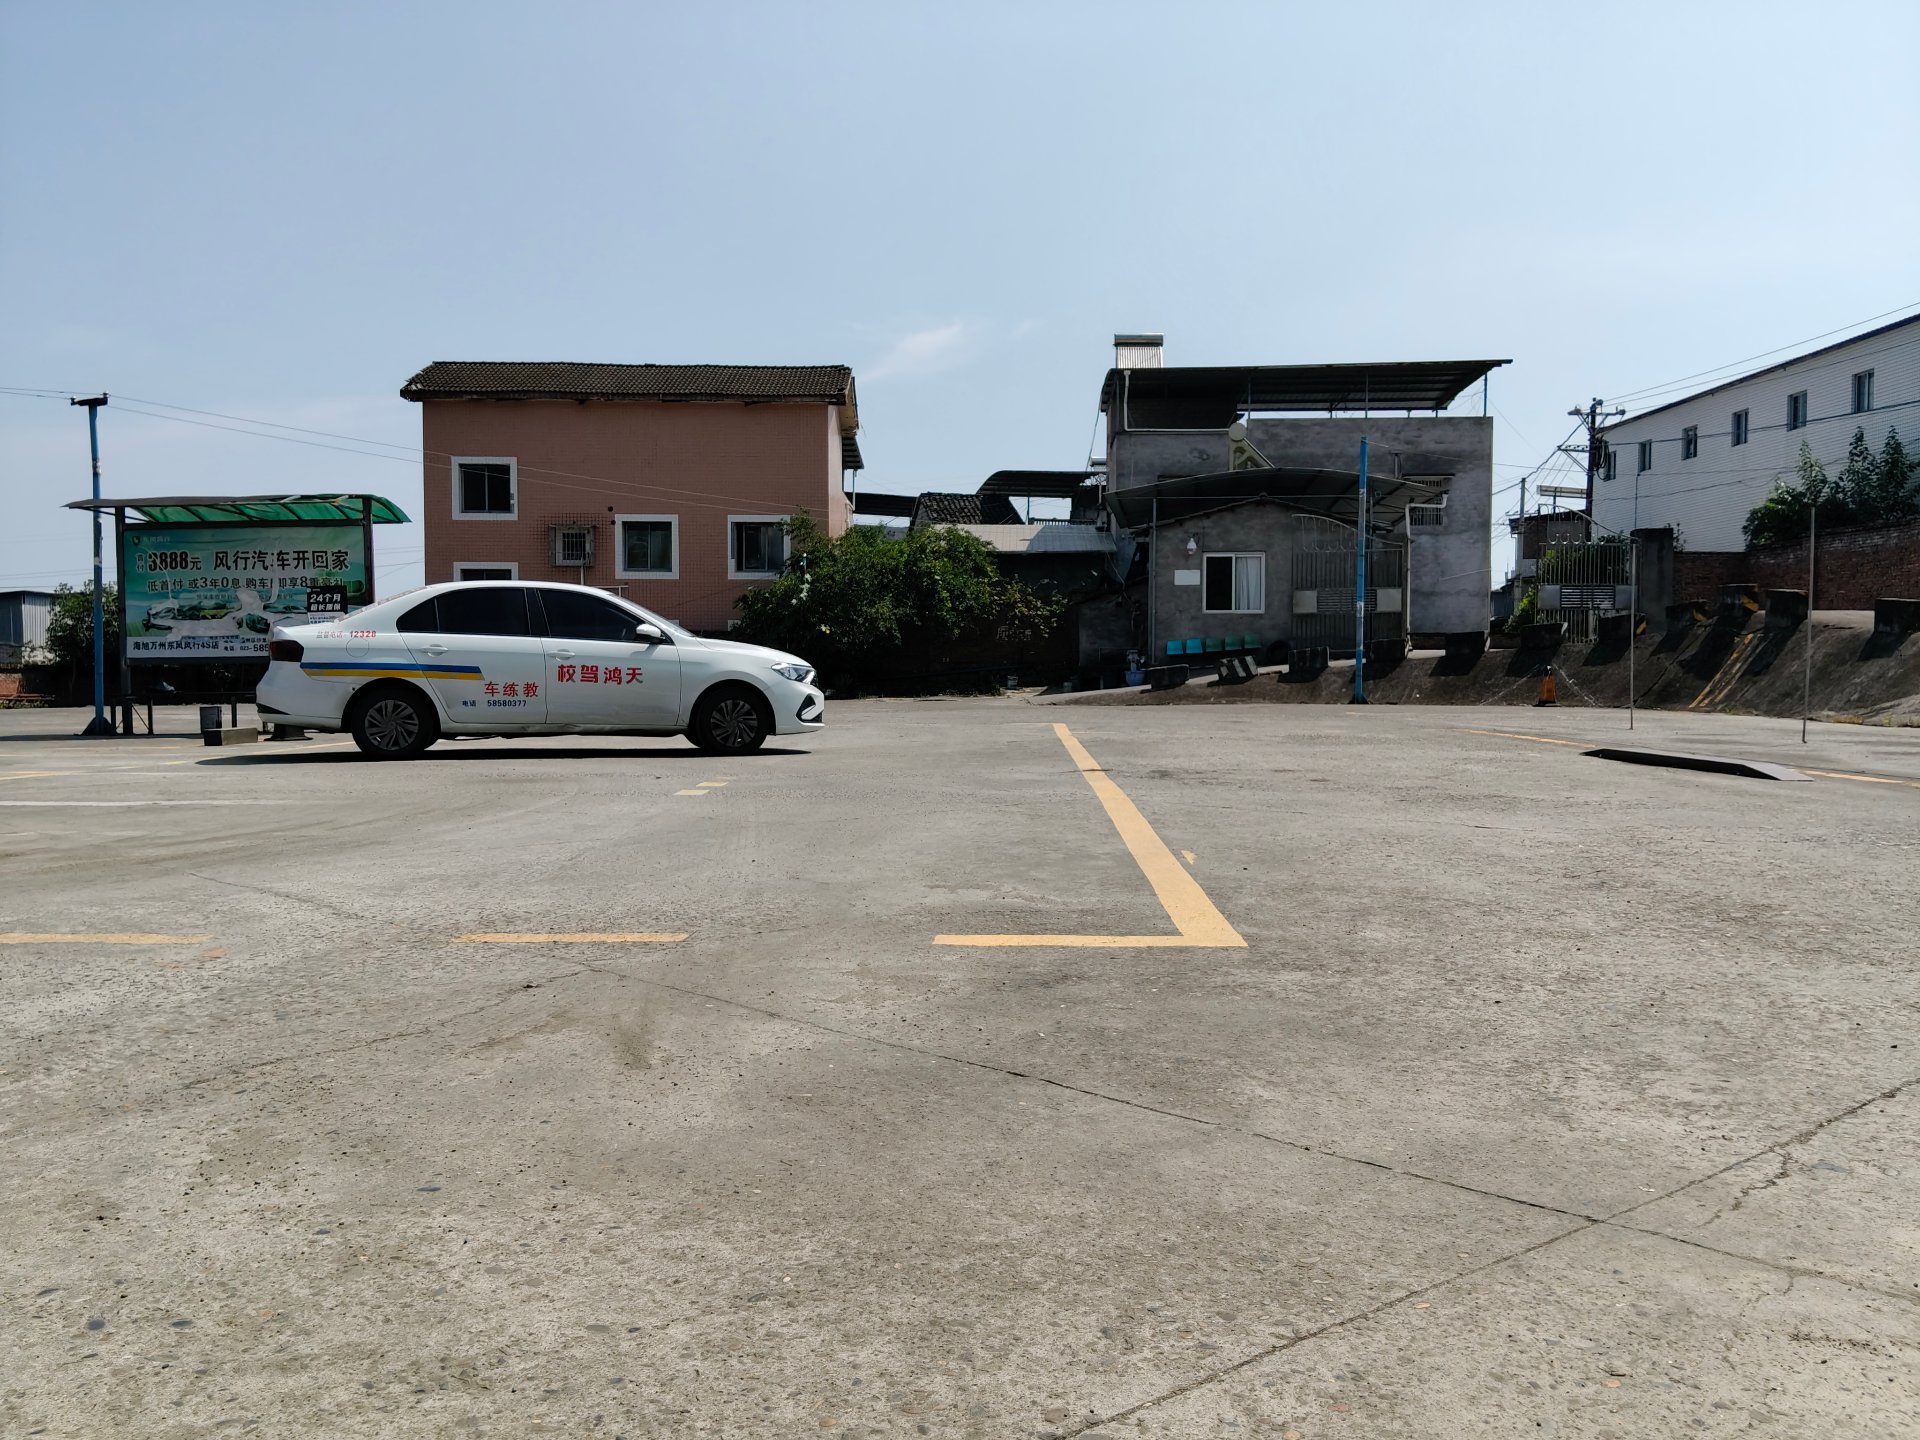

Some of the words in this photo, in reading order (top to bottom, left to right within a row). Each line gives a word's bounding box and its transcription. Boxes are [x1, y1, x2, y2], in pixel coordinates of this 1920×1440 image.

[213, 549, 350, 571] 风行汽车开回家
[309, 593, 342, 603] 24个月
[350, 630, 377, 639] 12328
[462, 699, 477, 708] 电话
[487, 699, 528, 708] 58580377
